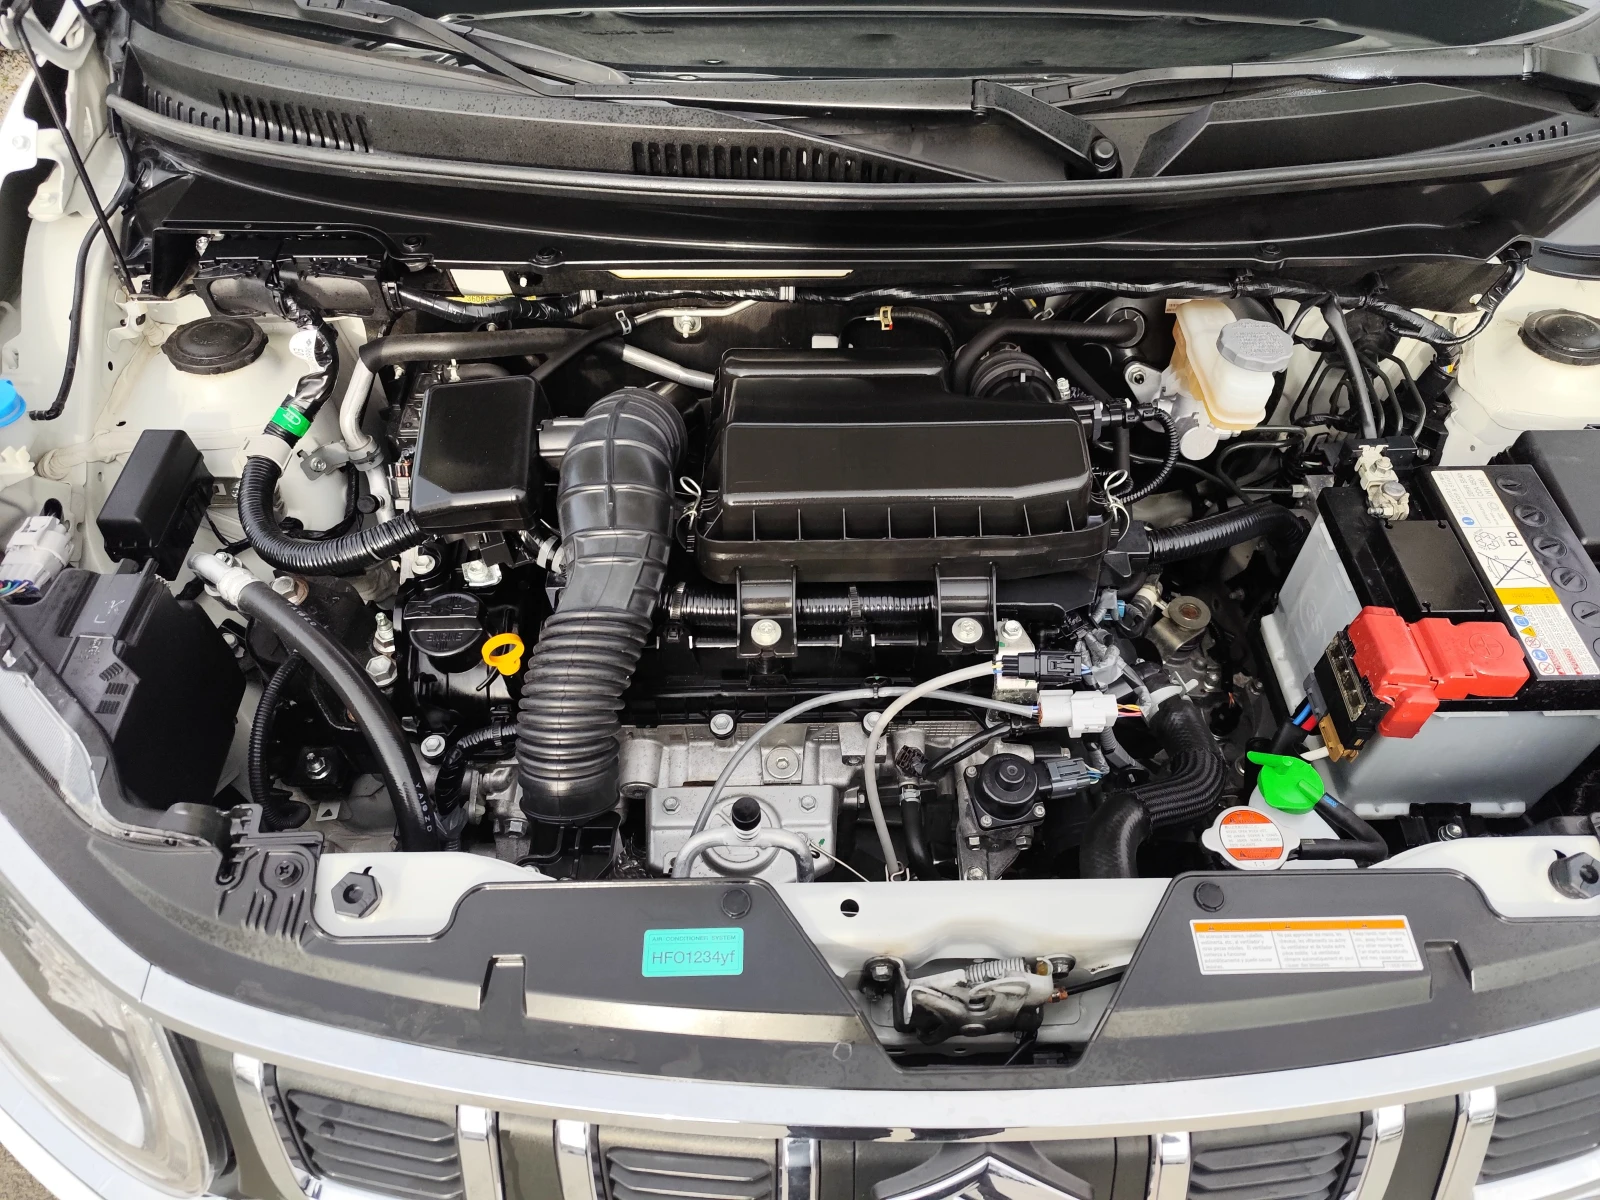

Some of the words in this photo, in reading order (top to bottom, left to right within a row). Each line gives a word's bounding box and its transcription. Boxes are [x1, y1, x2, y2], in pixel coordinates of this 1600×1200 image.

[1505, 532, 1519, 547] Pb
[426, 632, 463, 642] ENGINE
[652, 950, 735, 966] HFO1234yf
